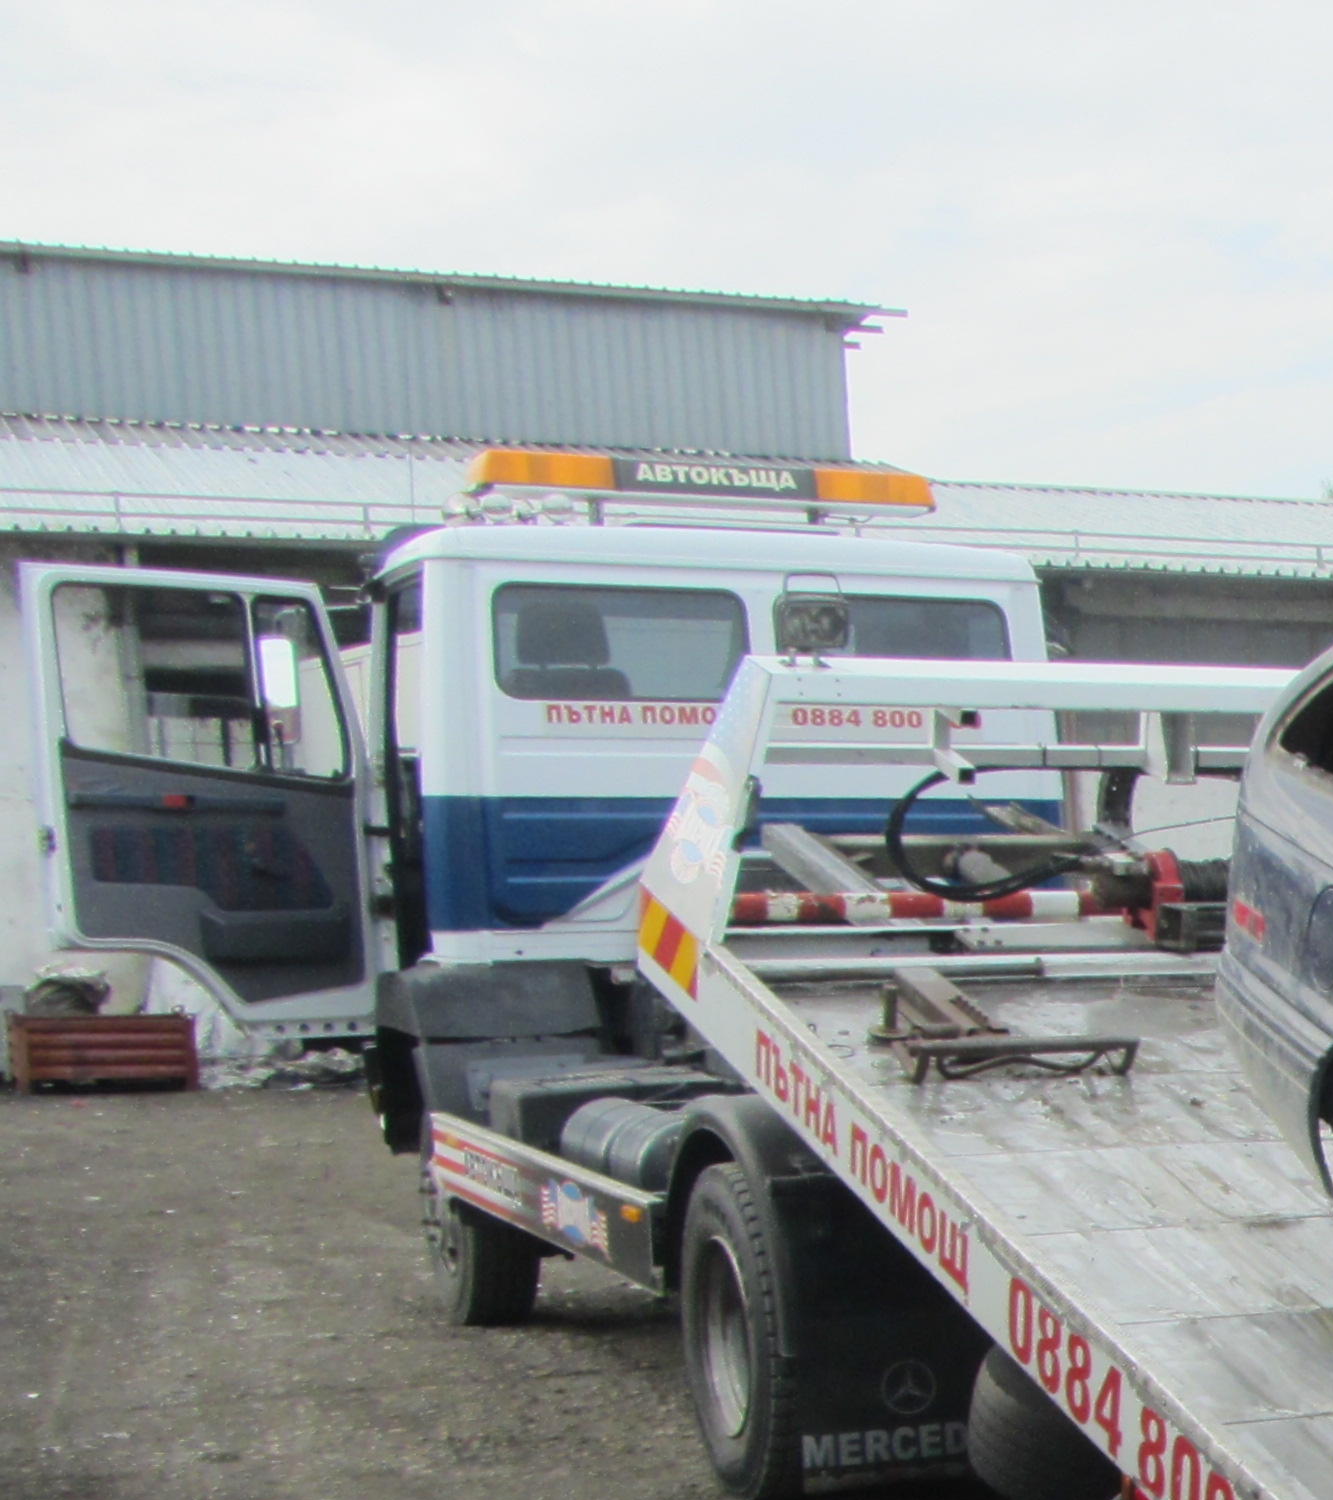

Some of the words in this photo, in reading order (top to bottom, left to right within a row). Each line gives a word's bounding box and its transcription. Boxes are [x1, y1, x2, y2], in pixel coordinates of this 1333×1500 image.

[636, 462, 798, 491] АВТОКЪЩА
[547, 704, 632, 725] ПЪТНА
[642, 705, 716, 725] ПОМО
[792, 708, 862, 728] 0884
[873, 710, 923, 729] 800
[756, 1028, 839, 1157] ПЪТНА
[851, 1121, 969, 1307] ПОМОЩ
[1009, 1276, 1123, 1460] 0884
[802, 1421, 967, 1469] MERCED
